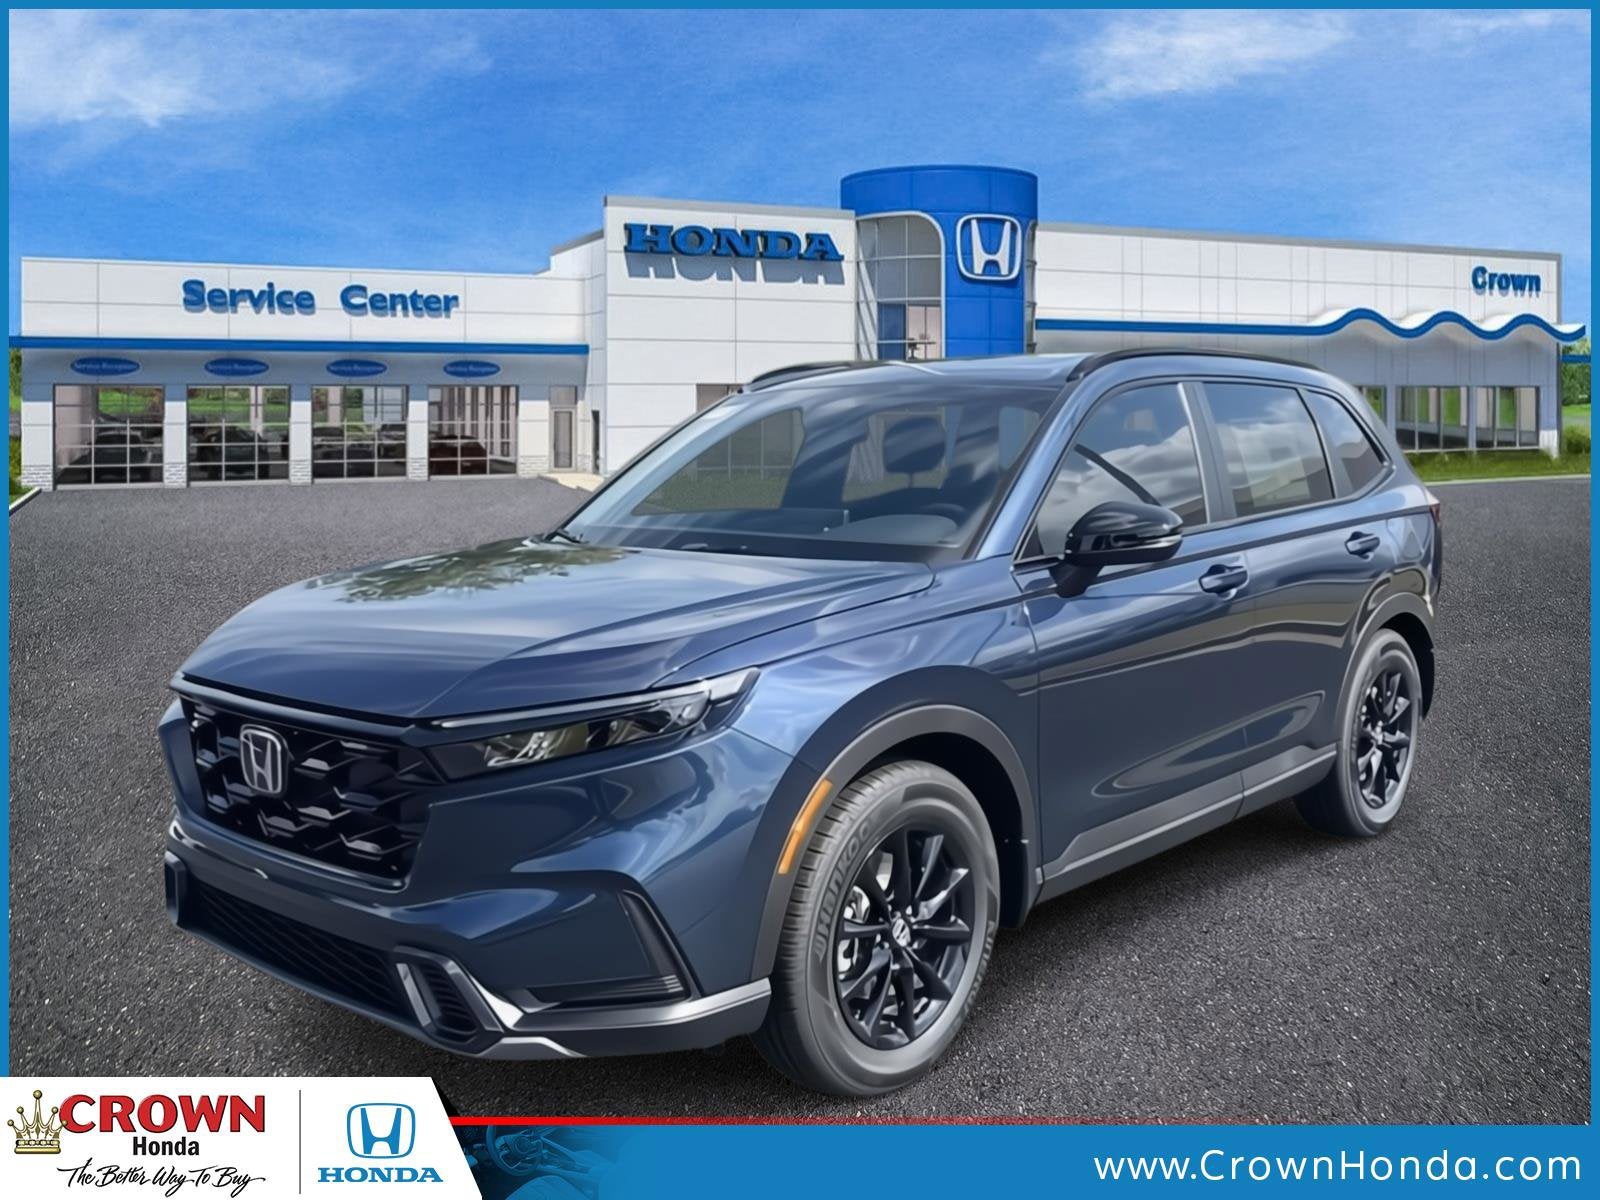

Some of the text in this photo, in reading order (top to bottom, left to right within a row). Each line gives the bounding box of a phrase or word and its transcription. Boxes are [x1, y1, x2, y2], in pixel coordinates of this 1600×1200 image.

[624, 222, 844, 262] HONDA
[1471, 265, 1542, 292] Crown
[182, 279, 460, 315] Service Center
